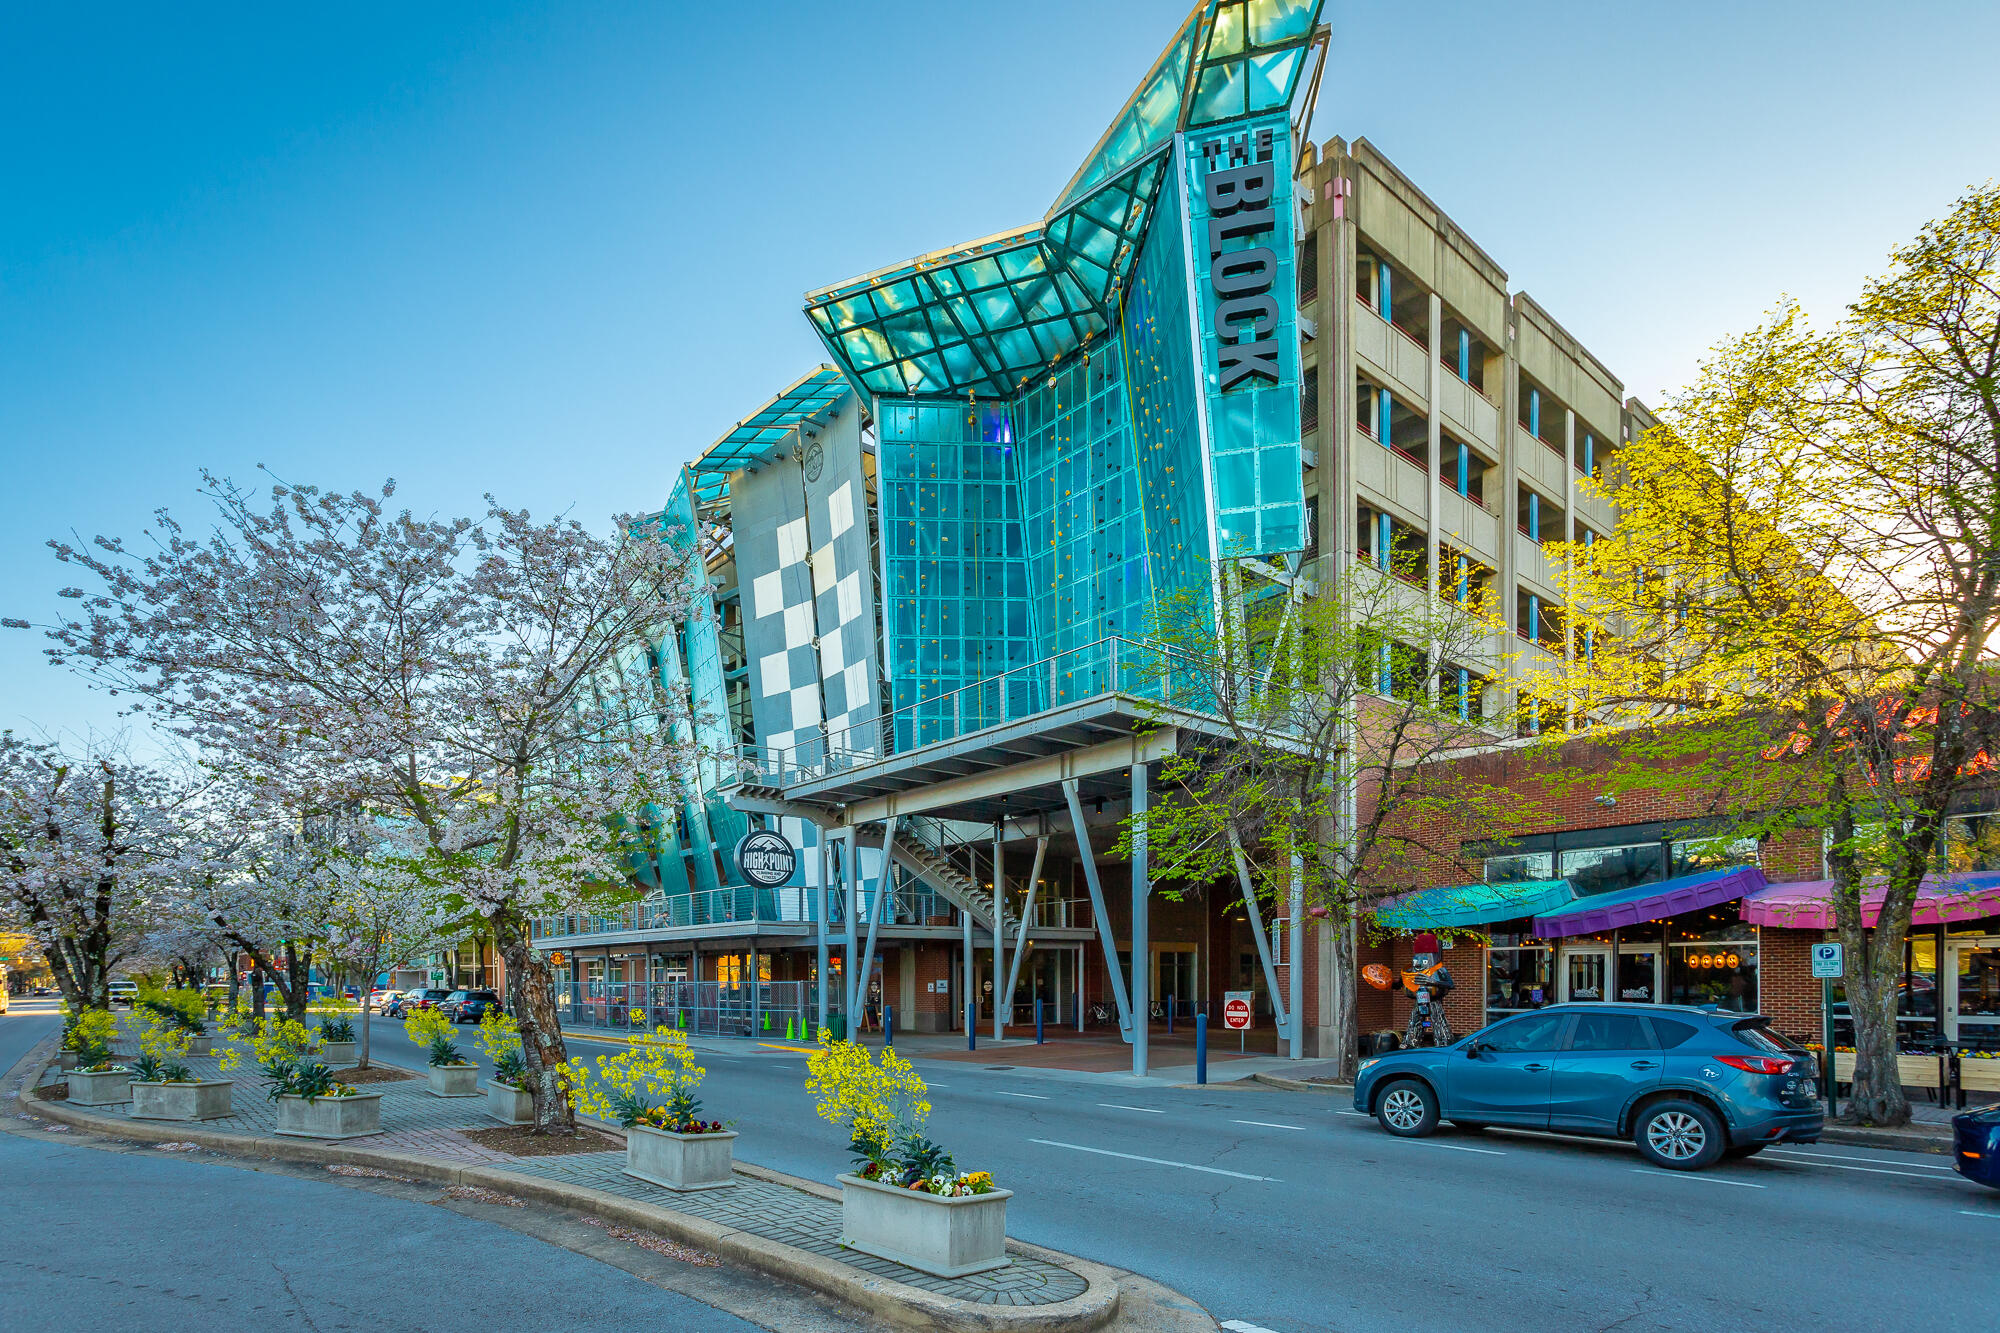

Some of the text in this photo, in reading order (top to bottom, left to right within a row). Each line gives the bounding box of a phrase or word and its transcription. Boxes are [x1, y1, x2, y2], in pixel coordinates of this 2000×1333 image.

[1202, 128, 1275, 171] THE
[1205, 162, 1279, 392] BLOCK
[744, 852, 793, 871] HIGH POINT
